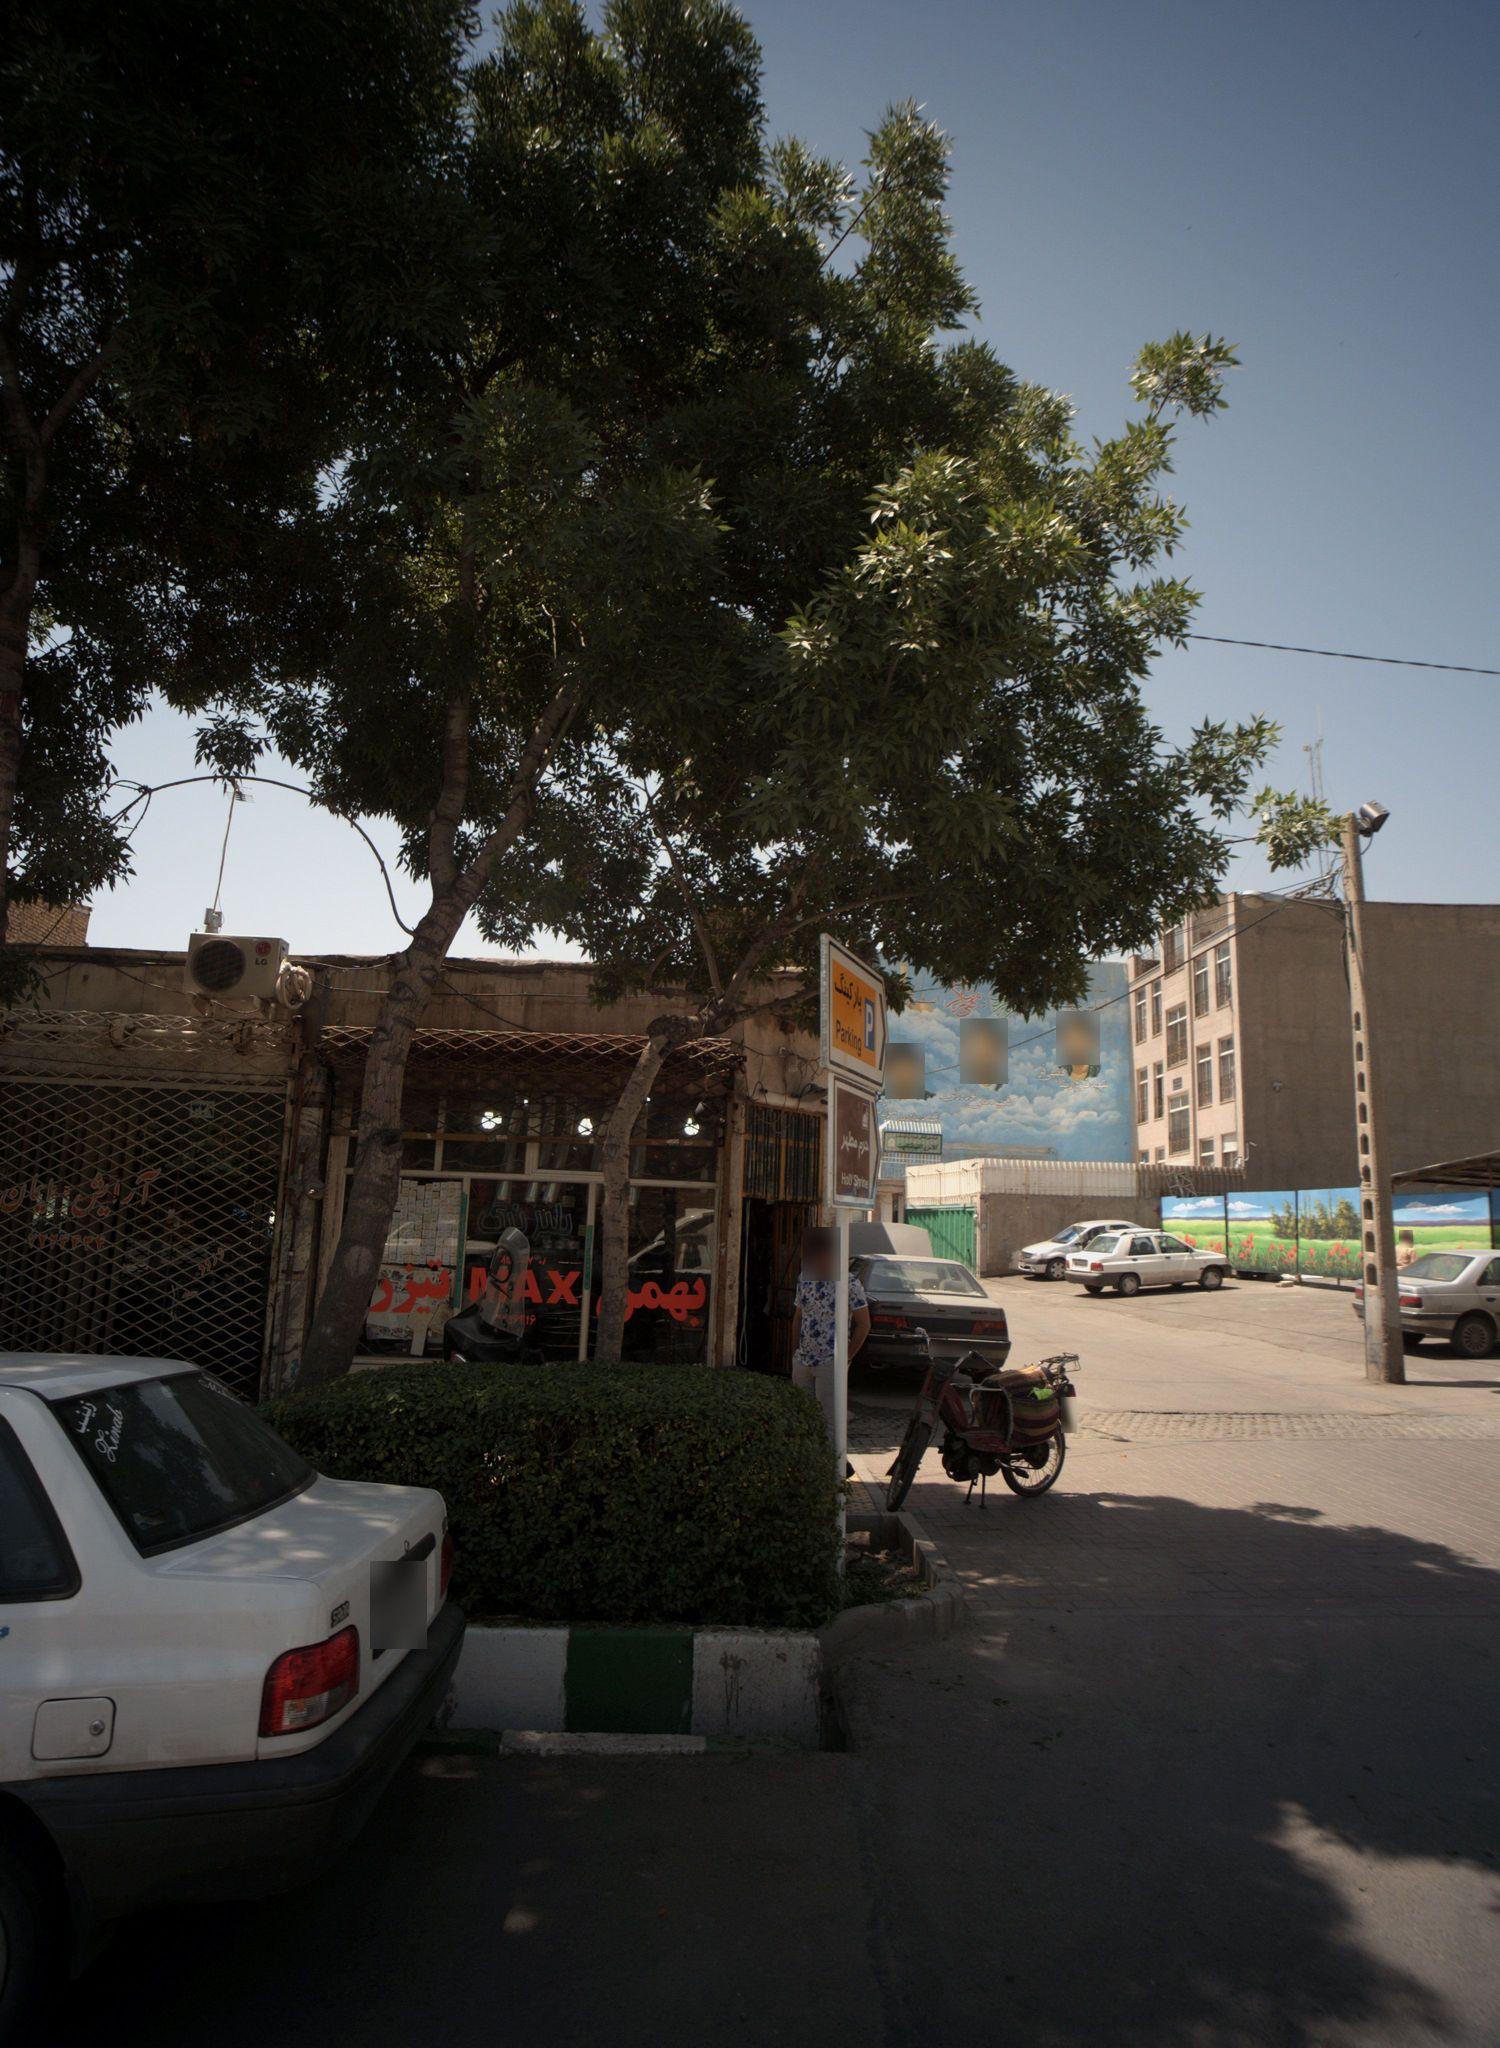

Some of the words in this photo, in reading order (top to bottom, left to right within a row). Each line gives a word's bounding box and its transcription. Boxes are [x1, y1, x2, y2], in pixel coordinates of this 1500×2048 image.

[255, 957, 268, 966] LG
[834, 973, 862, 1015] پارکینگ
[836, 1019, 862, 1057] Parking
[840, 1130, 858, 1152] مطهر
[469, 1265, 582, 1307] MAX
